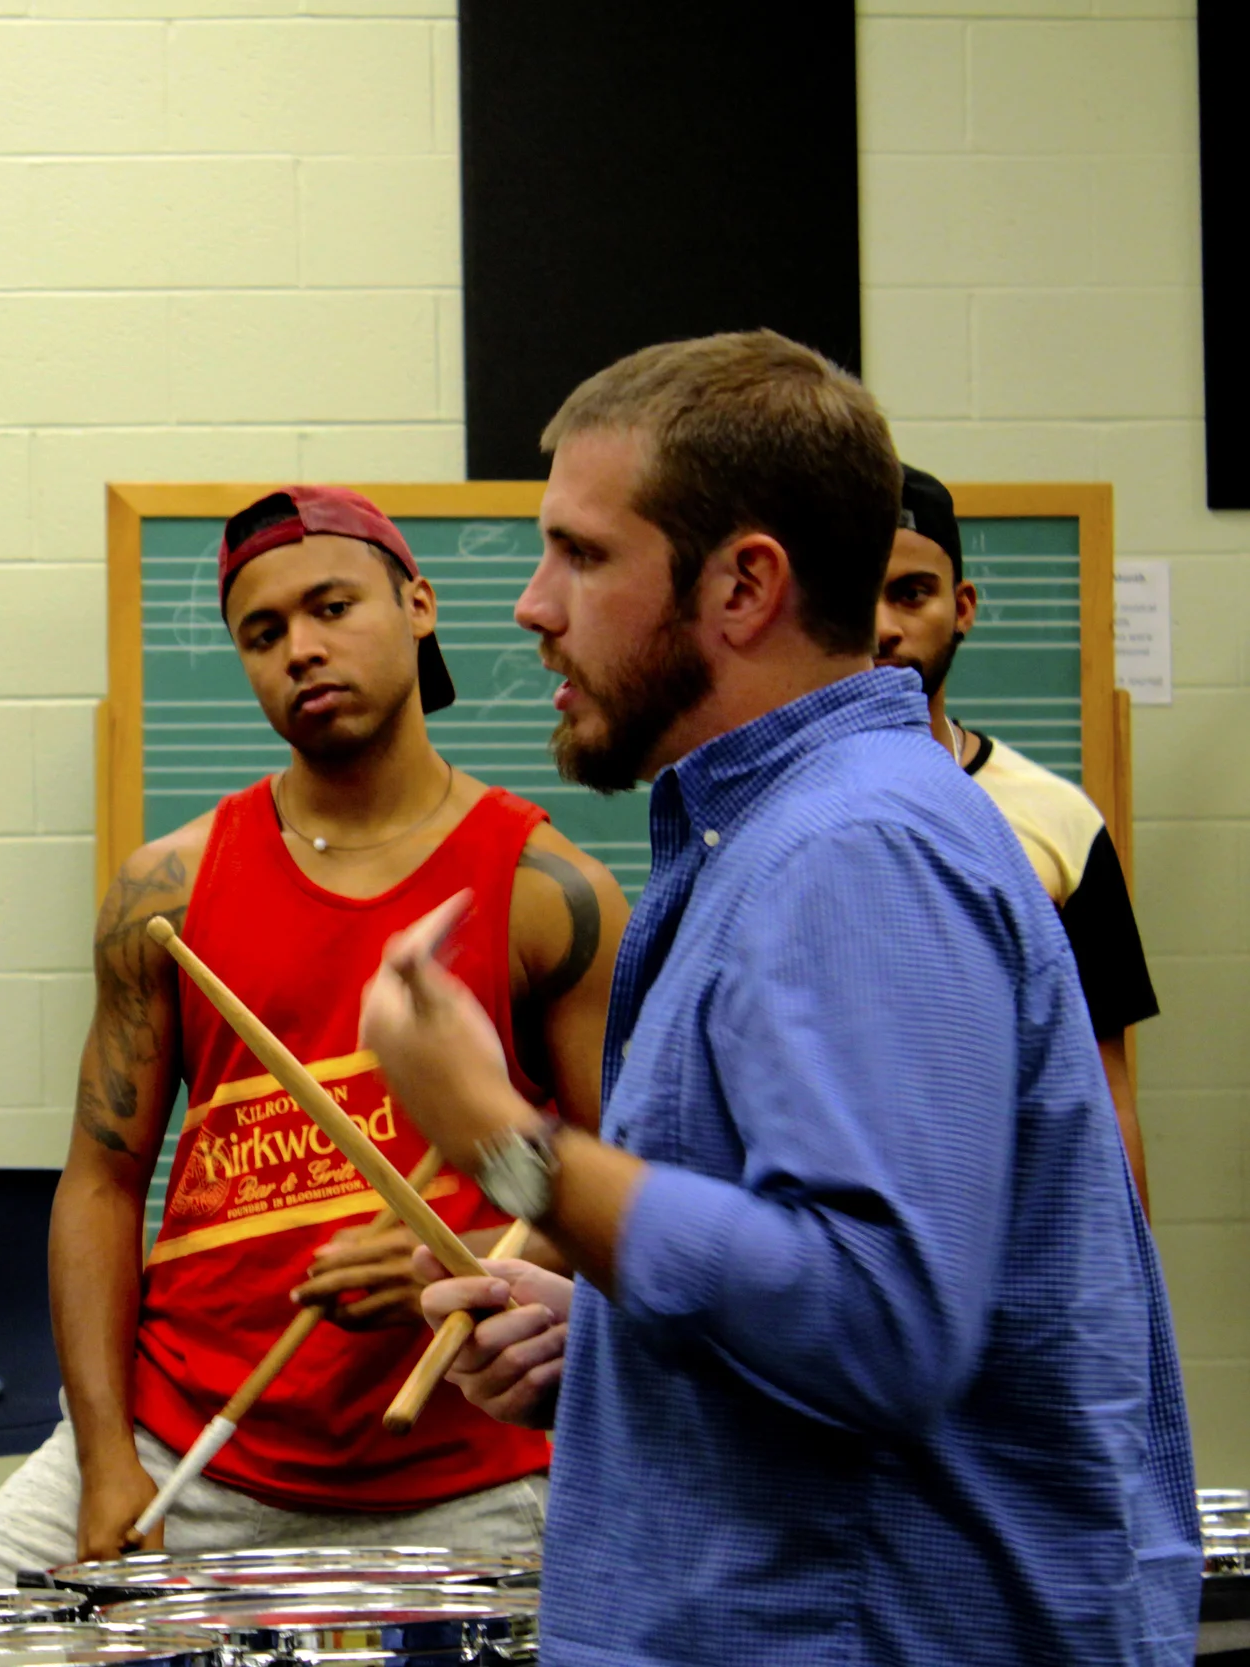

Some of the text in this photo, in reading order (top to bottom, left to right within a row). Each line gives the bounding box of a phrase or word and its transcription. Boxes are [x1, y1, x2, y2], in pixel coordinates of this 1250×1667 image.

[234, 1175, 277, 1205] Bar
[280, 1171, 298, 1193] &
[227, 1200, 269, 1219] FOUNDED
[272, 1197, 284, 1209] IN
